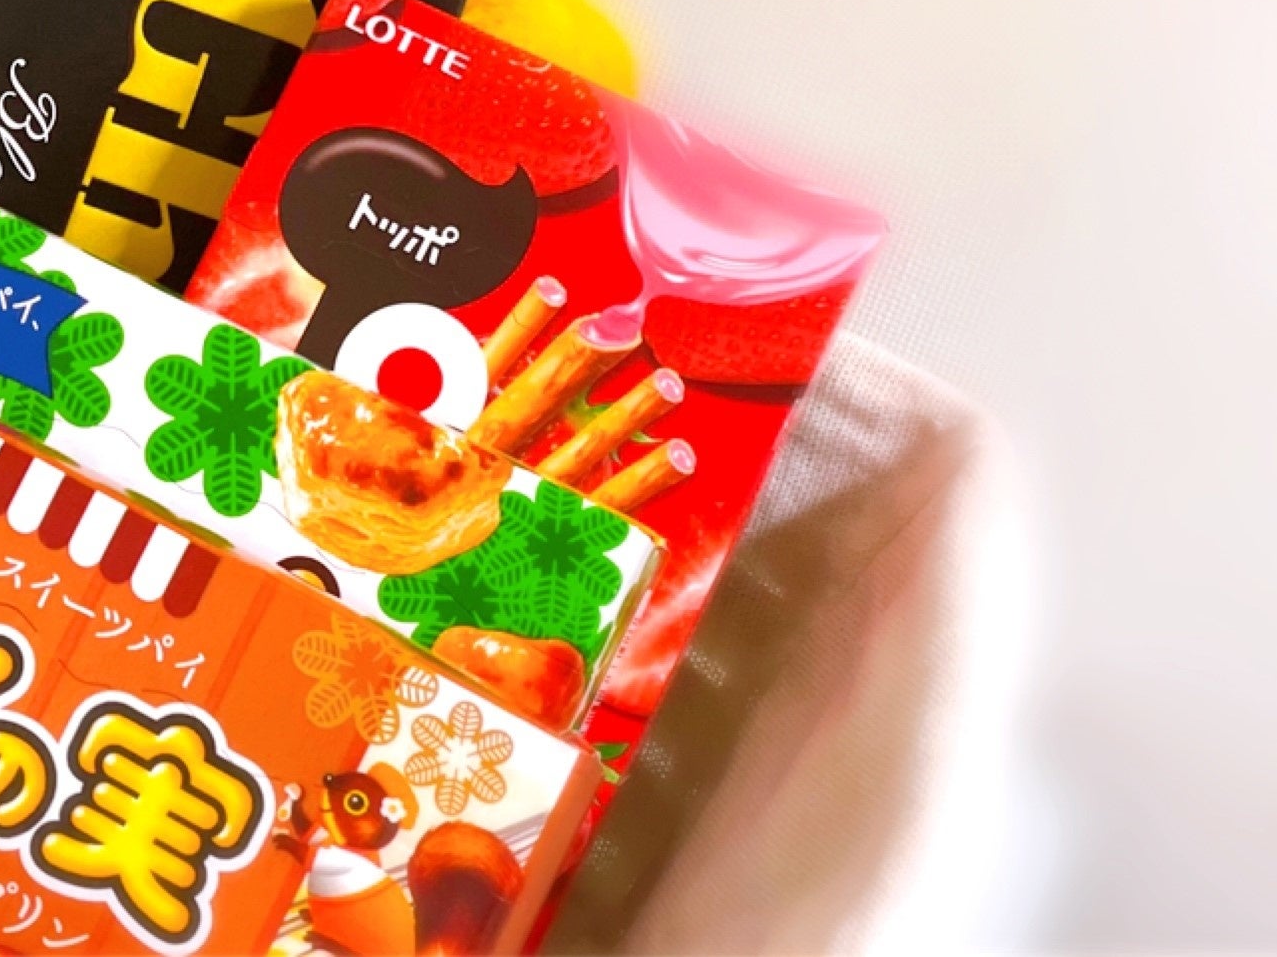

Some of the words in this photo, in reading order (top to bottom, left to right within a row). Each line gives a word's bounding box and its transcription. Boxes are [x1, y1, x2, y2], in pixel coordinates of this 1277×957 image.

[343, 4, 471, 81] LOTTE
[348, 193, 461, 266] トッポ
